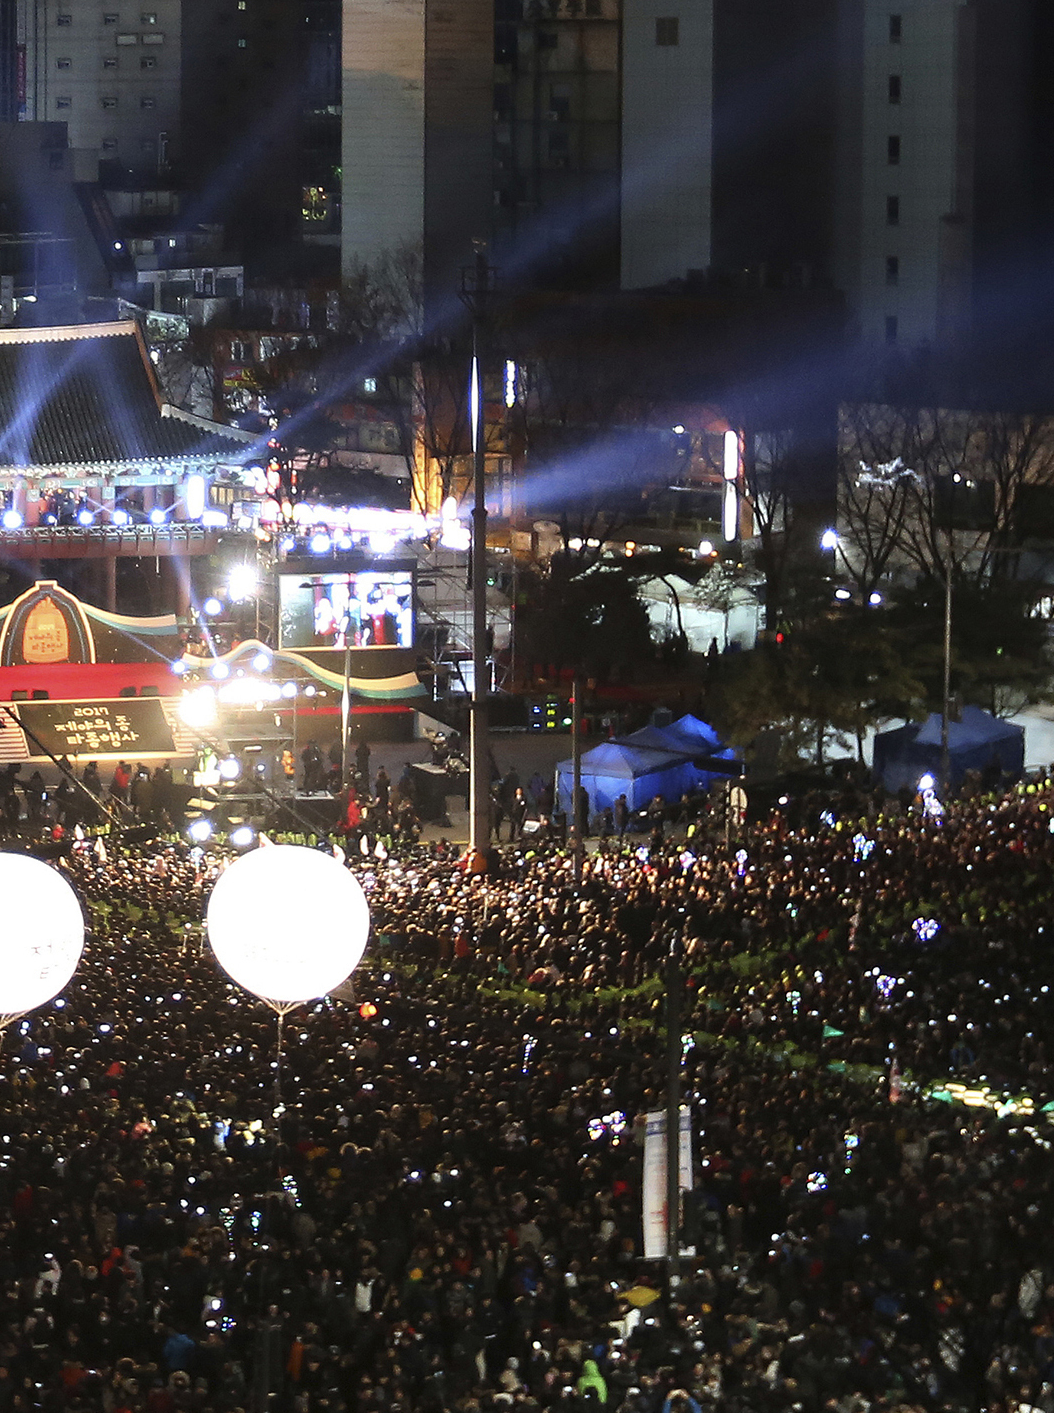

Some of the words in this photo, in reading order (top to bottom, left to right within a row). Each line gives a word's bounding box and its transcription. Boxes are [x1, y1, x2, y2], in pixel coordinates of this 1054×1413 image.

[74, 706, 110, 717] 2017
[54, 718, 112, 732] 제야의
[114, 714, 131, 732] 종
[66, 731, 140, 749] 타종행사
